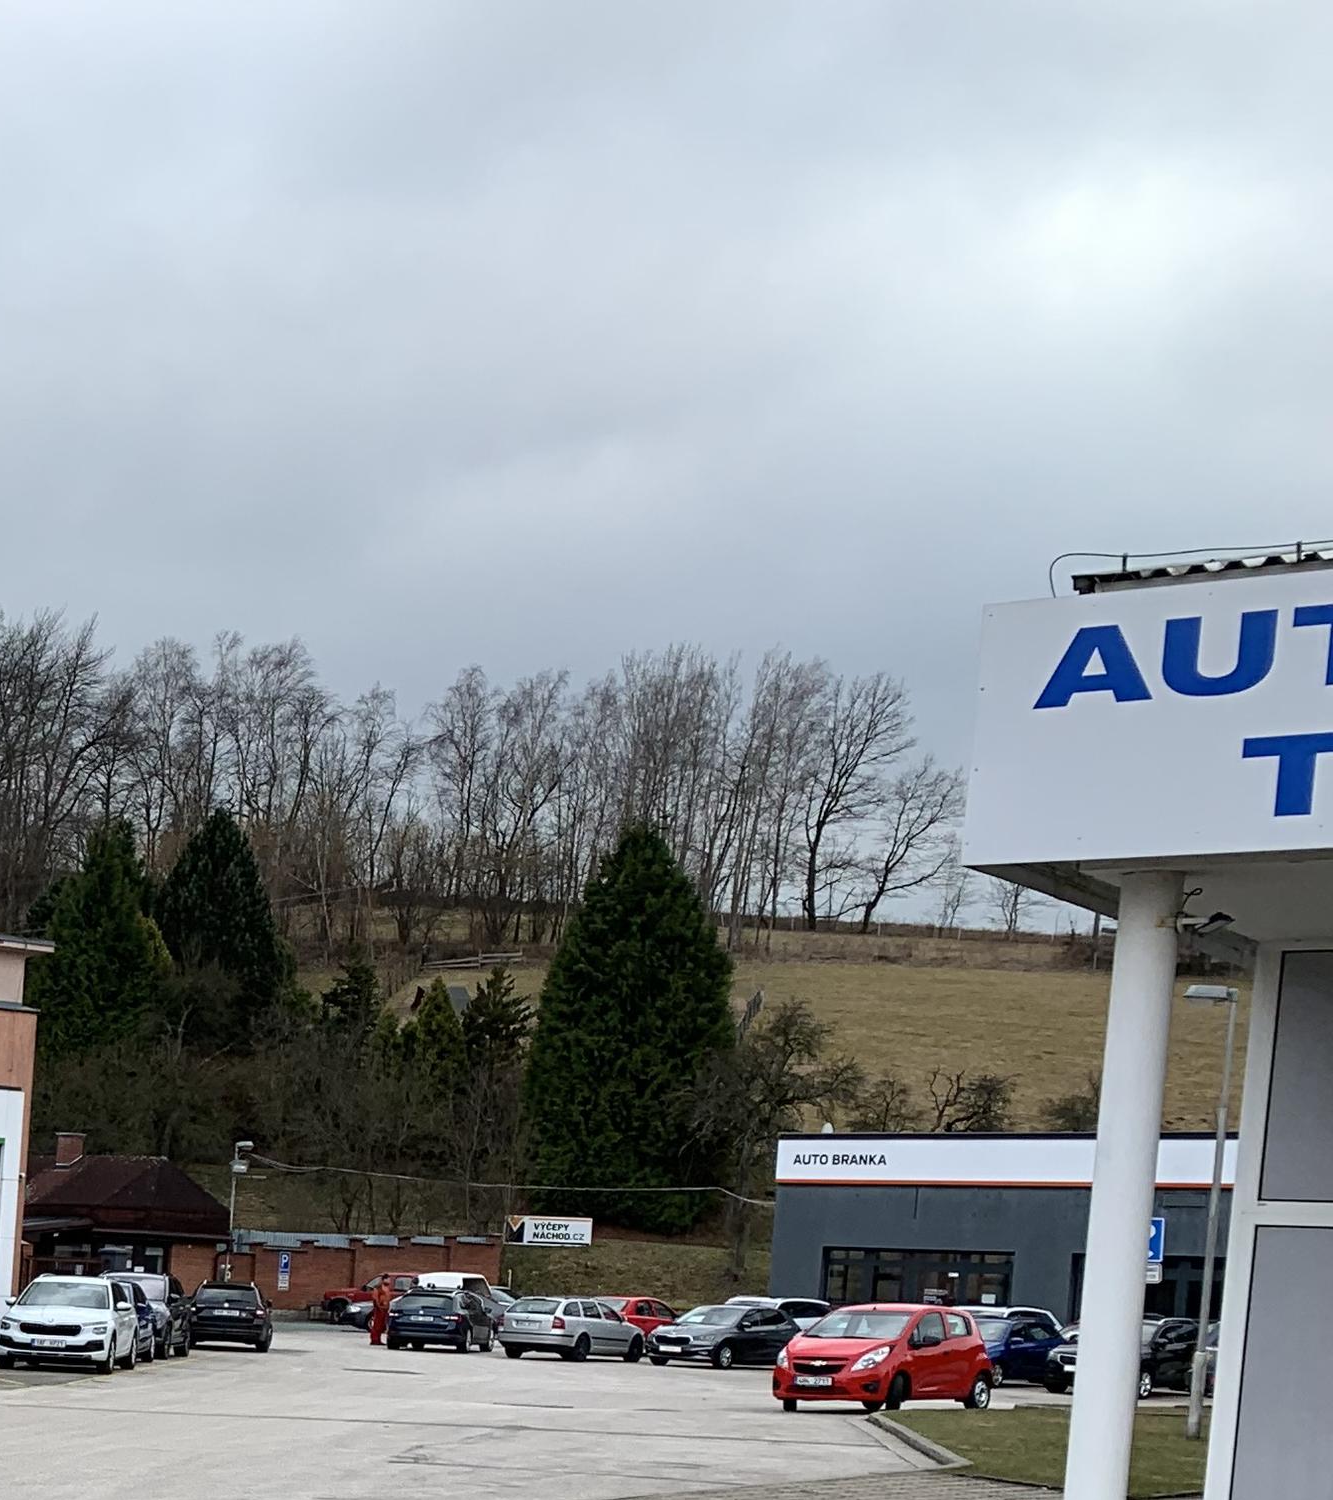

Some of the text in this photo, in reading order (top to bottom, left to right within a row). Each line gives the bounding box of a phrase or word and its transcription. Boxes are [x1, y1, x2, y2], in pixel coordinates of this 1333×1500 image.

[793, 1154, 887, 1166] AUTO BRANKA
[281, 1254, 289, 1268] P
